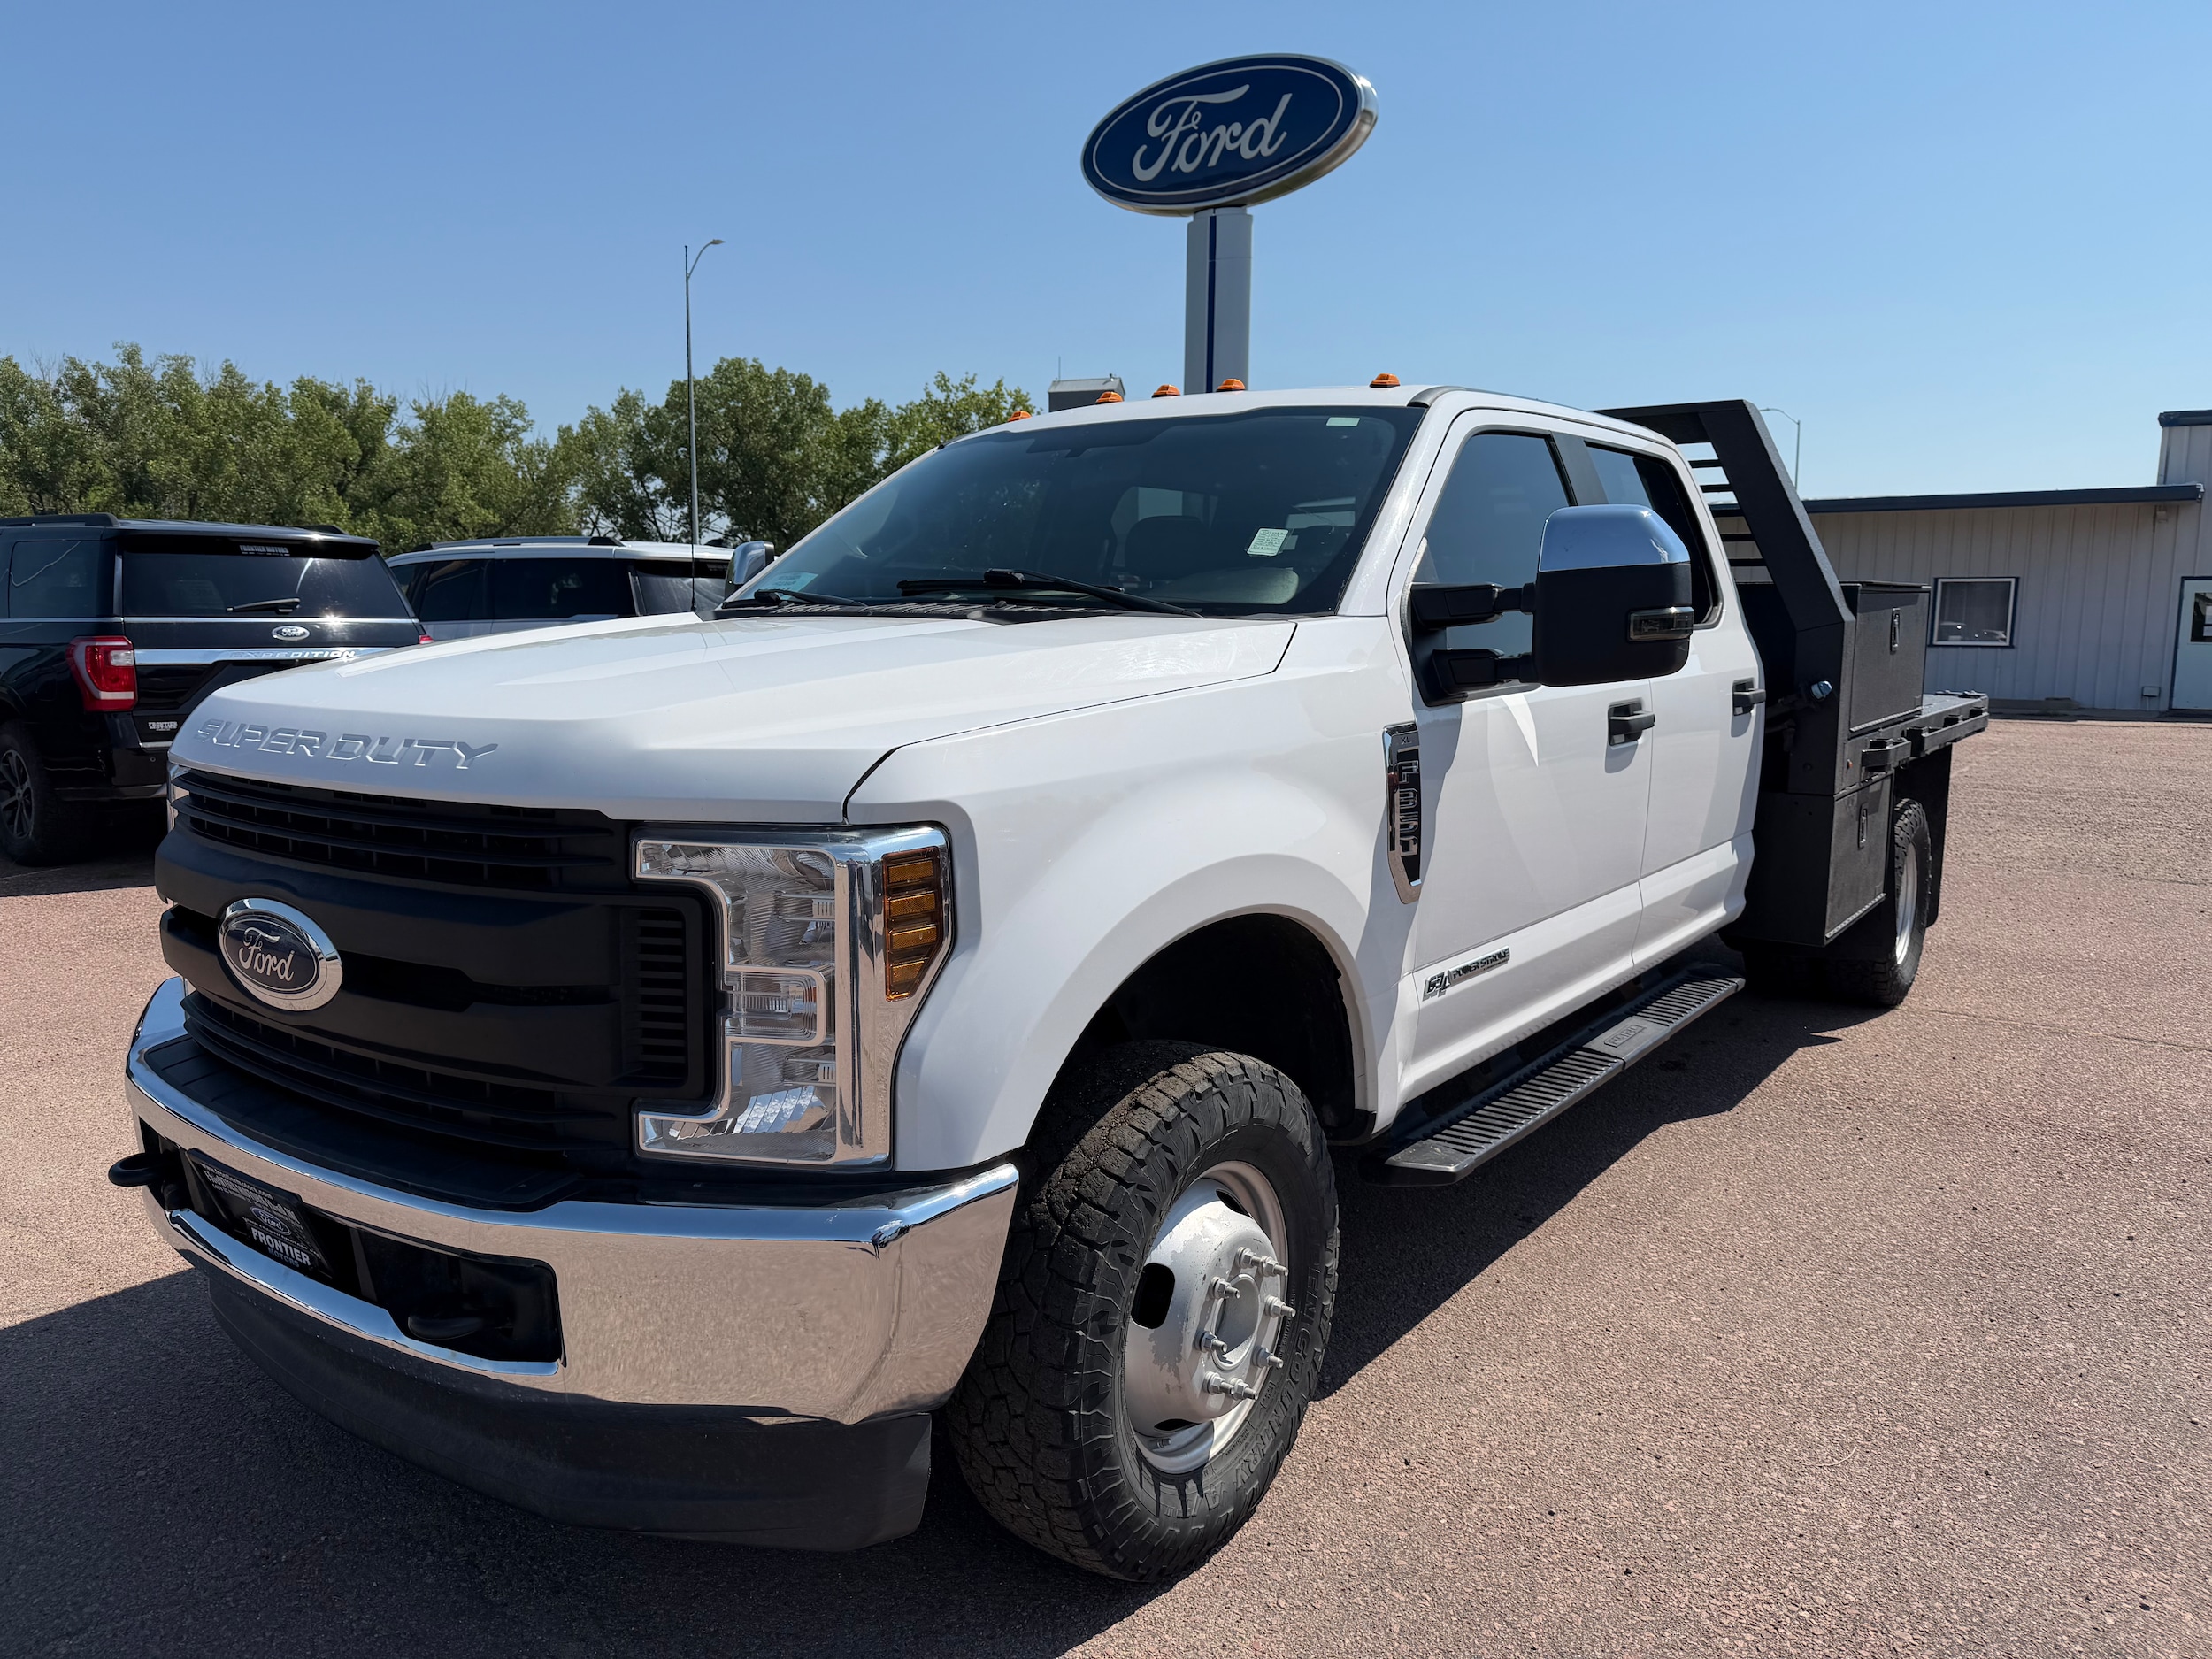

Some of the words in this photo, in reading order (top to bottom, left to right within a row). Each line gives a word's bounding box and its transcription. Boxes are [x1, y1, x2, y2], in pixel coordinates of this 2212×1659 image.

[1132, 83, 1293, 182] Ford
[281, 627, 303, 636] Ford
[196, 718, 327, 757] SUPER
[326, 733, 499, 770] DUTY
[238, 926, 296, 982] Ford
[1452, 960, 1481, 979] POWER
[1480, 947, 1510, 968] STROKE
[258, 1210, 284, 1231] Ford
[250, 1226, 311, 1266] FRONTIER
[267, 1246, 300, 1268] MOTORS
